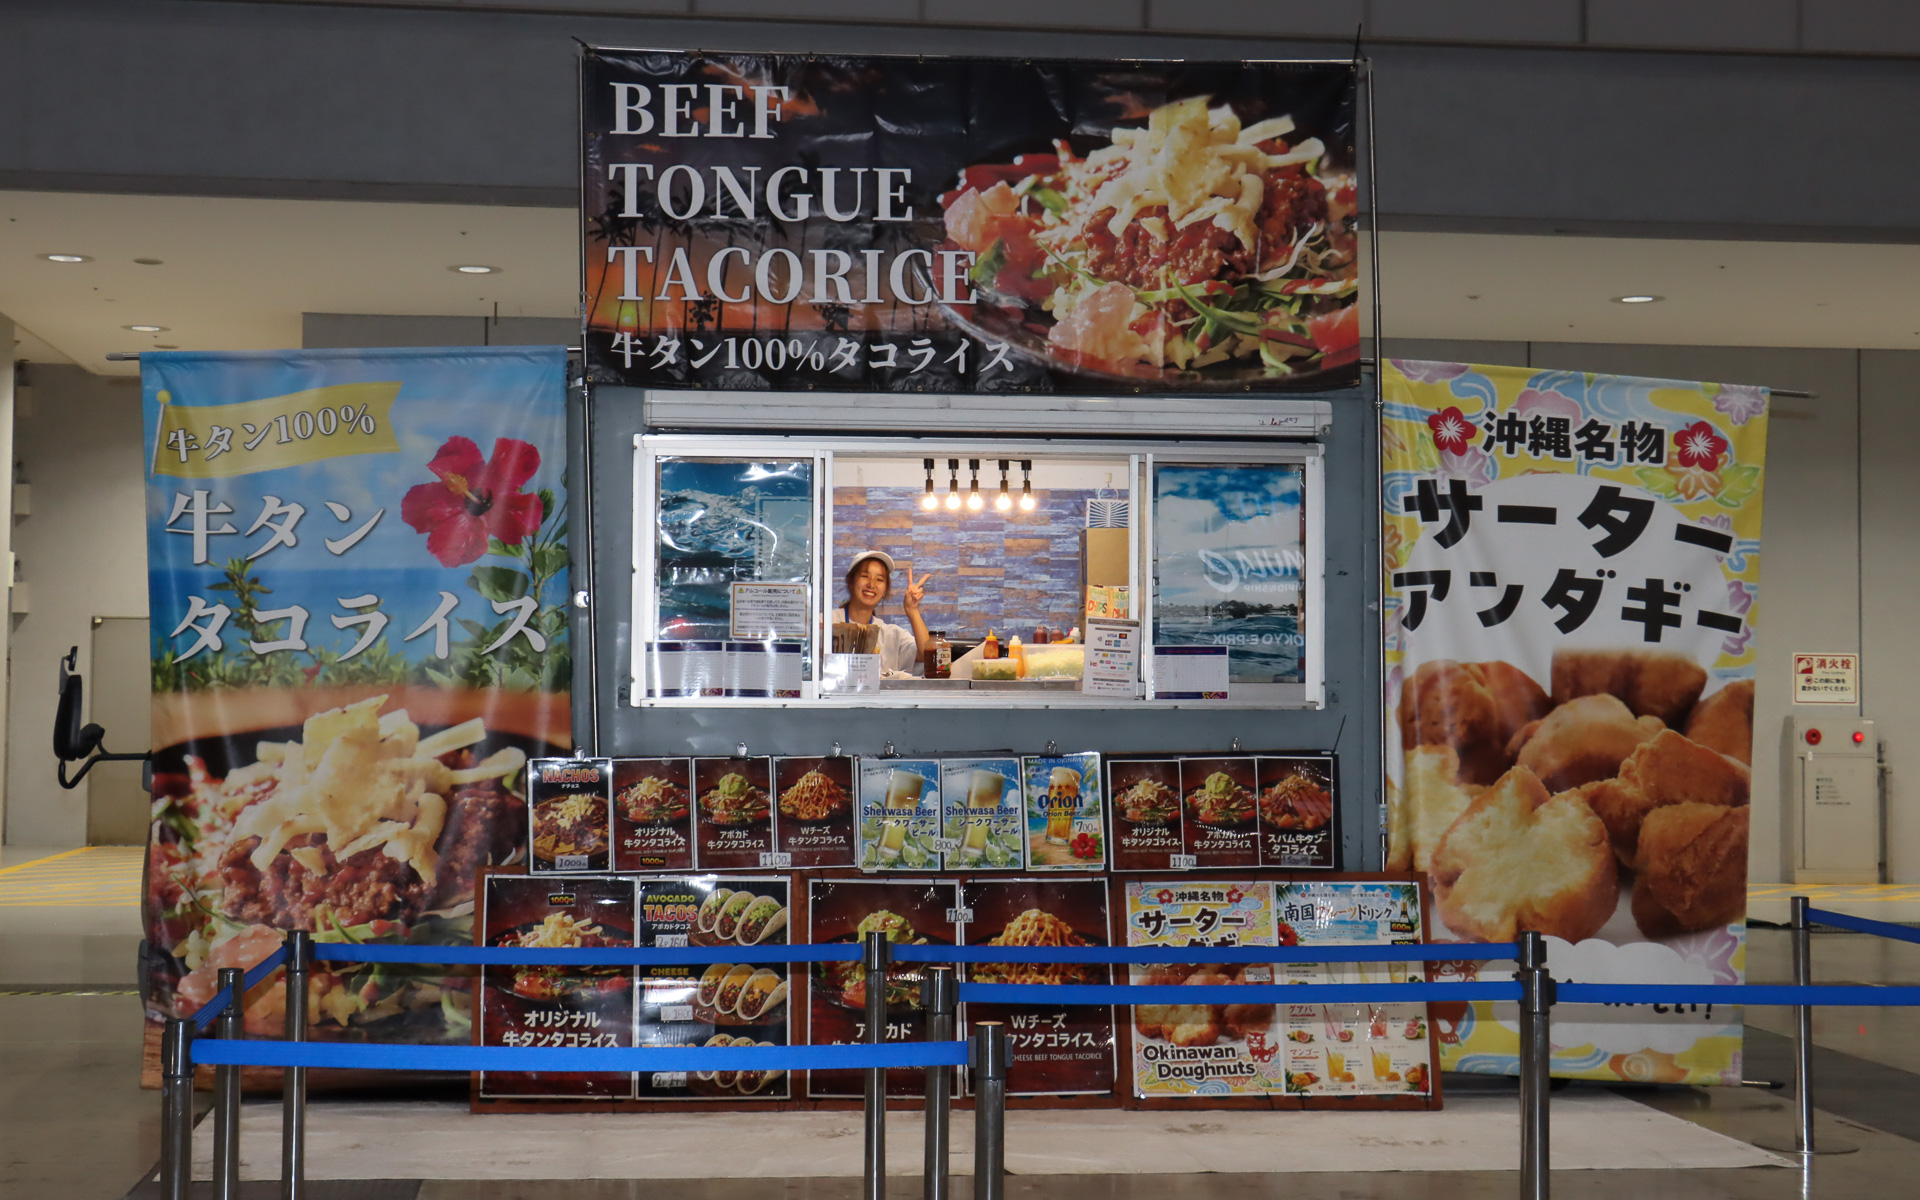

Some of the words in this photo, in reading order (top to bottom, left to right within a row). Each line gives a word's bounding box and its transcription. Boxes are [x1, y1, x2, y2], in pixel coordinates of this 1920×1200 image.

[609, 82, 789, 140] BEEF
[609, 164, 914, 223] TONGUE
[608, 246, 978, 305] TACORICE
[610, 332, 1015, 374] 牛タン100%タコライス
[167, 404, 376, 463] 牛タン100%
[1483, 411, 1666, 464] 沖縄名物
[1404, 479, 1734, 559] サーター
[165, 490, 385, 565] 牛タン
[1394, 568, 1743, 643] アンダギー
[170, 591, 548, 664] タコライス
[1816, 658, 1851, 669] 消火栓
[542, 768, 600, 783] NACHOS
[1038, 792, 1084, 809] Orion
[864, 806, 913, 816] Shekwasa
[915, 806, 937, 816] Beer
[946, 805, 995, 816] Shekwasa
[997, 805, 1019, 815] Beer
[1042, 810, 1062, 818] Orion
[958, 818, 1017, 827] シークワーサー
[634, 827, 675, 837] オリジナル
[720, 830, 749, 839] アボカド
[800, 826, 831, 835] Wチーズ
[912, 829, 936, 837] ビール
[995, 828, 1018, 836] ビール
[1132, 827, 1170, 837] オリジナル
[624, 837, 686, 848] 牛タンタコライス
[707, 839, 765, 849] 牛タンタコライス
[788, 835, 846, 846] 牛タンタコライス
[1122, 838, 1178, 847] 牛タンタコライス
[1194, 840, 1252, 849] 牛タンタコライス
[1272, 844, 1319, 854] タコライス
[646, 895, 696, 903] AVOCADO
[1175, 891, 1224, 902] 沖縄名物
[643, 904, 698, 922] TACOS
[1138, 908, 1245, 937] サーター
[650, 968, 689, 976] CHEESE
[1289, 1005, 1313, 1013] グアバ
[524, 1010, 601, 1028] オリジナル
[1010, 1013, 1067, 1029] Wチーズ
[856, 1023, 912, 1039] アカド
[502, 1031, 619, 1047] 牛タンタコライス
[1034, 1053, 1048, 1061] BEEF
[1049, 1053, 1074, 1061] TONGUE
[1143, 1045, 1236, 1060] Okinawan
[1157, 1062, 1256, 1080] Doughnuts
